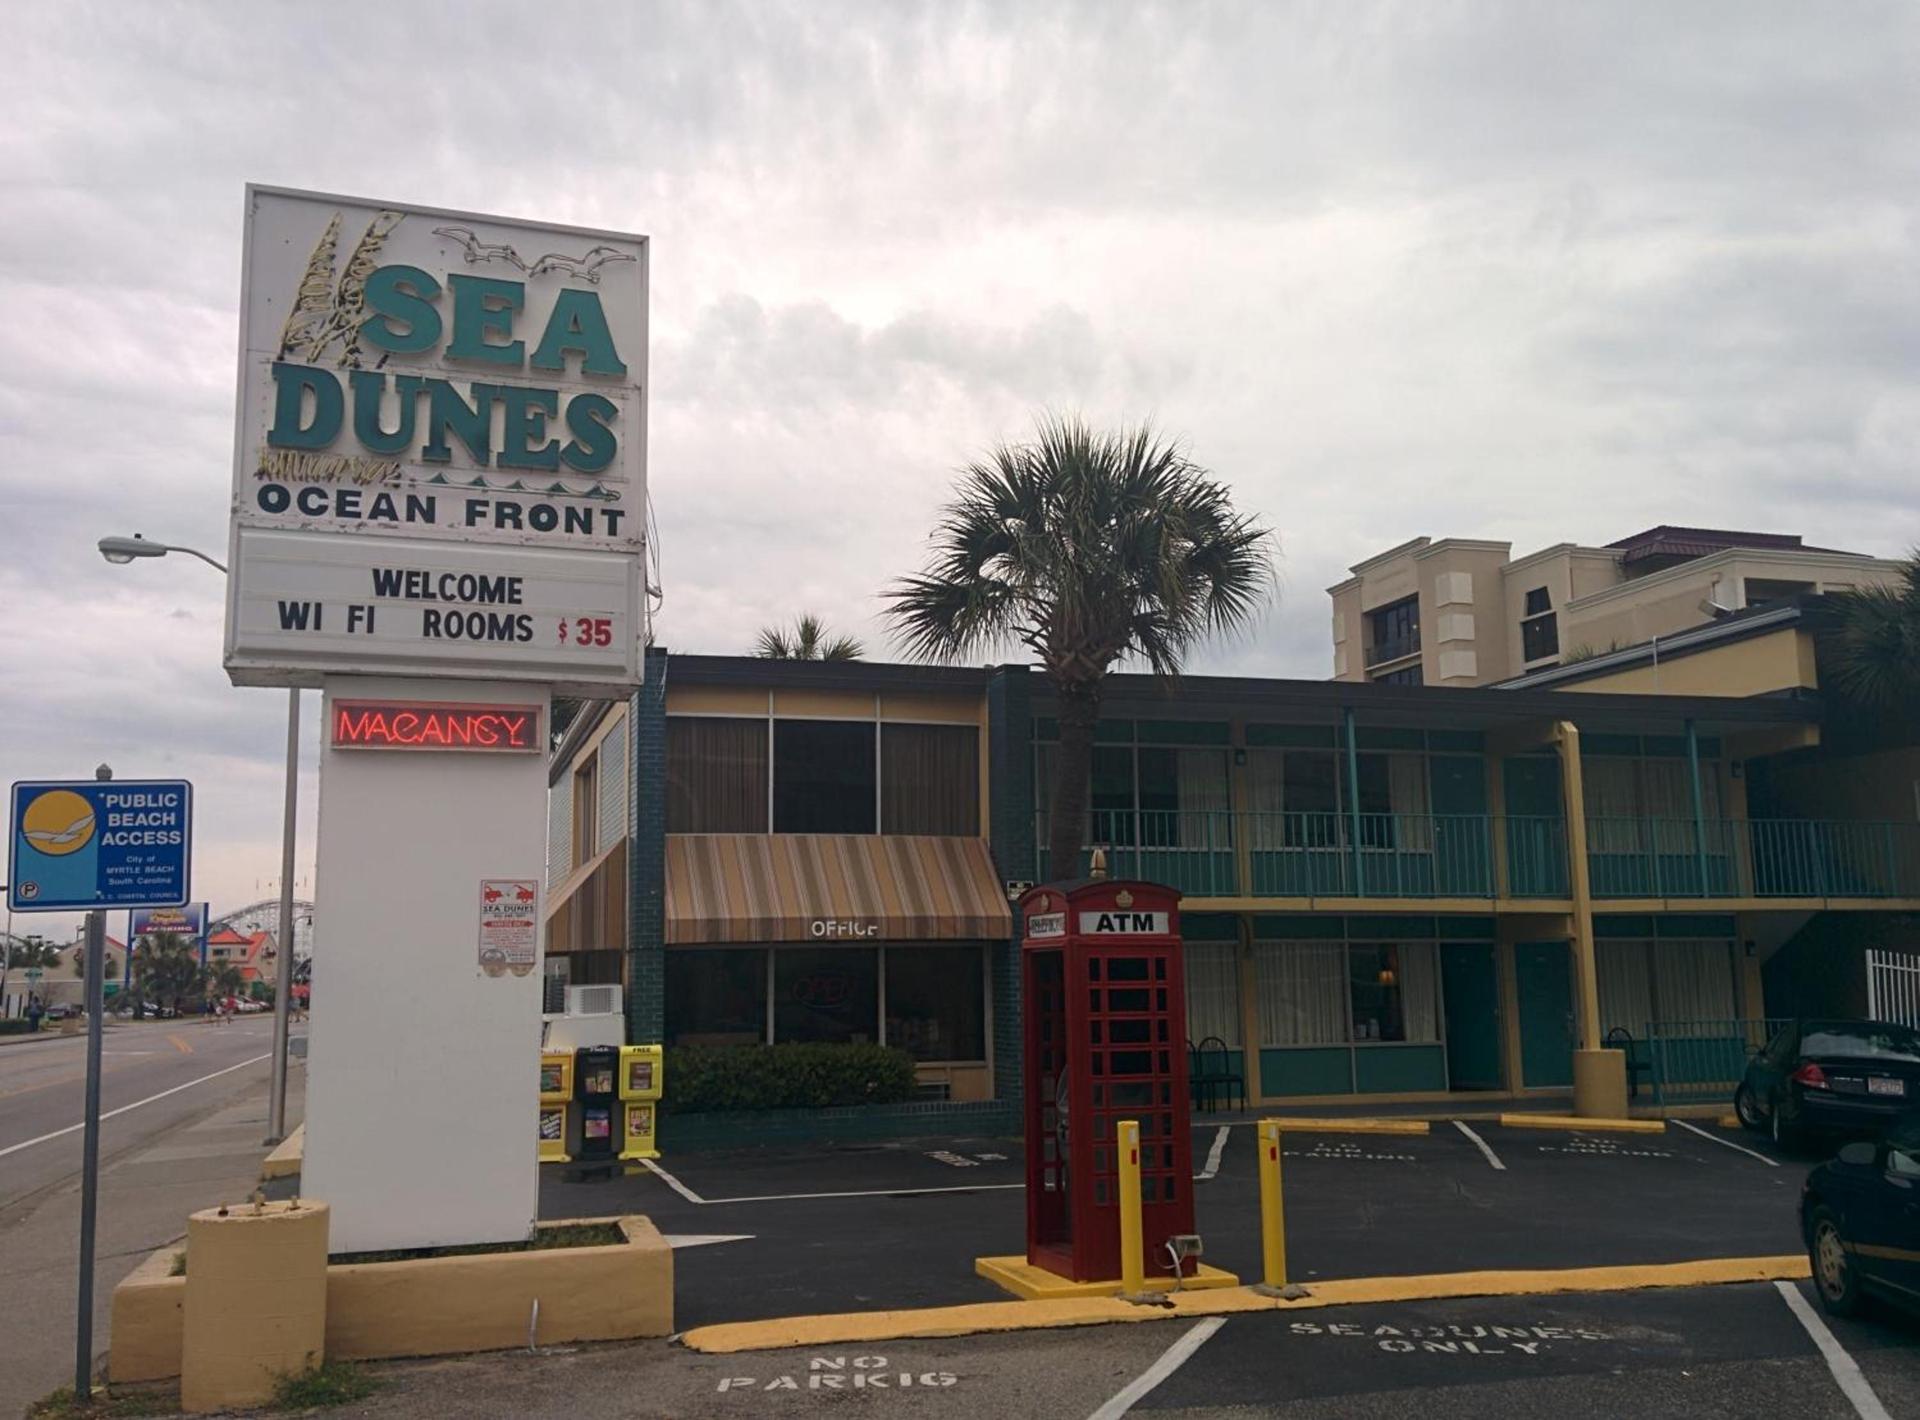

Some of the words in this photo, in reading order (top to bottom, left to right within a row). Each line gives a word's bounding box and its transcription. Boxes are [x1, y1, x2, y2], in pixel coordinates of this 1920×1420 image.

[359, 264, 627, 376] SEA
[267, 361, 620, 473] DUNES
[257, 484, 437, 524] OCEAN
[465, 499, 626, 537] FRONT
[372, 568, 523, 604] WELCOME
[278, 601, 322, 631] WI
[347, 605, 375, 634] FI
[422, 610, 534, 642] ROOMS
[106, 793, 178, 808] PUBLIC
[108, 812, 176, 827] BEACH
[101, 831, 182, 846] ACCESS
[126, 855, 143, 864] City
[147, 855, 155, 863] of
[106, 866, 140, 874] MYRTLE
[144, 865, 175, 873] BEACH
[108, 877, 134, 886] South
[136, 876, 172, 885] Carolina
[503, 904, 534, 912] DUNES
[811, 920, 878, 937] OFFICE
[1095, 912, 1155, 933] ATM
[1378, 1340, 1540, 1355] ONLY
[810, 1356, 888, 1370] NO
[716, 1371, 958, 1393] PARKIG
